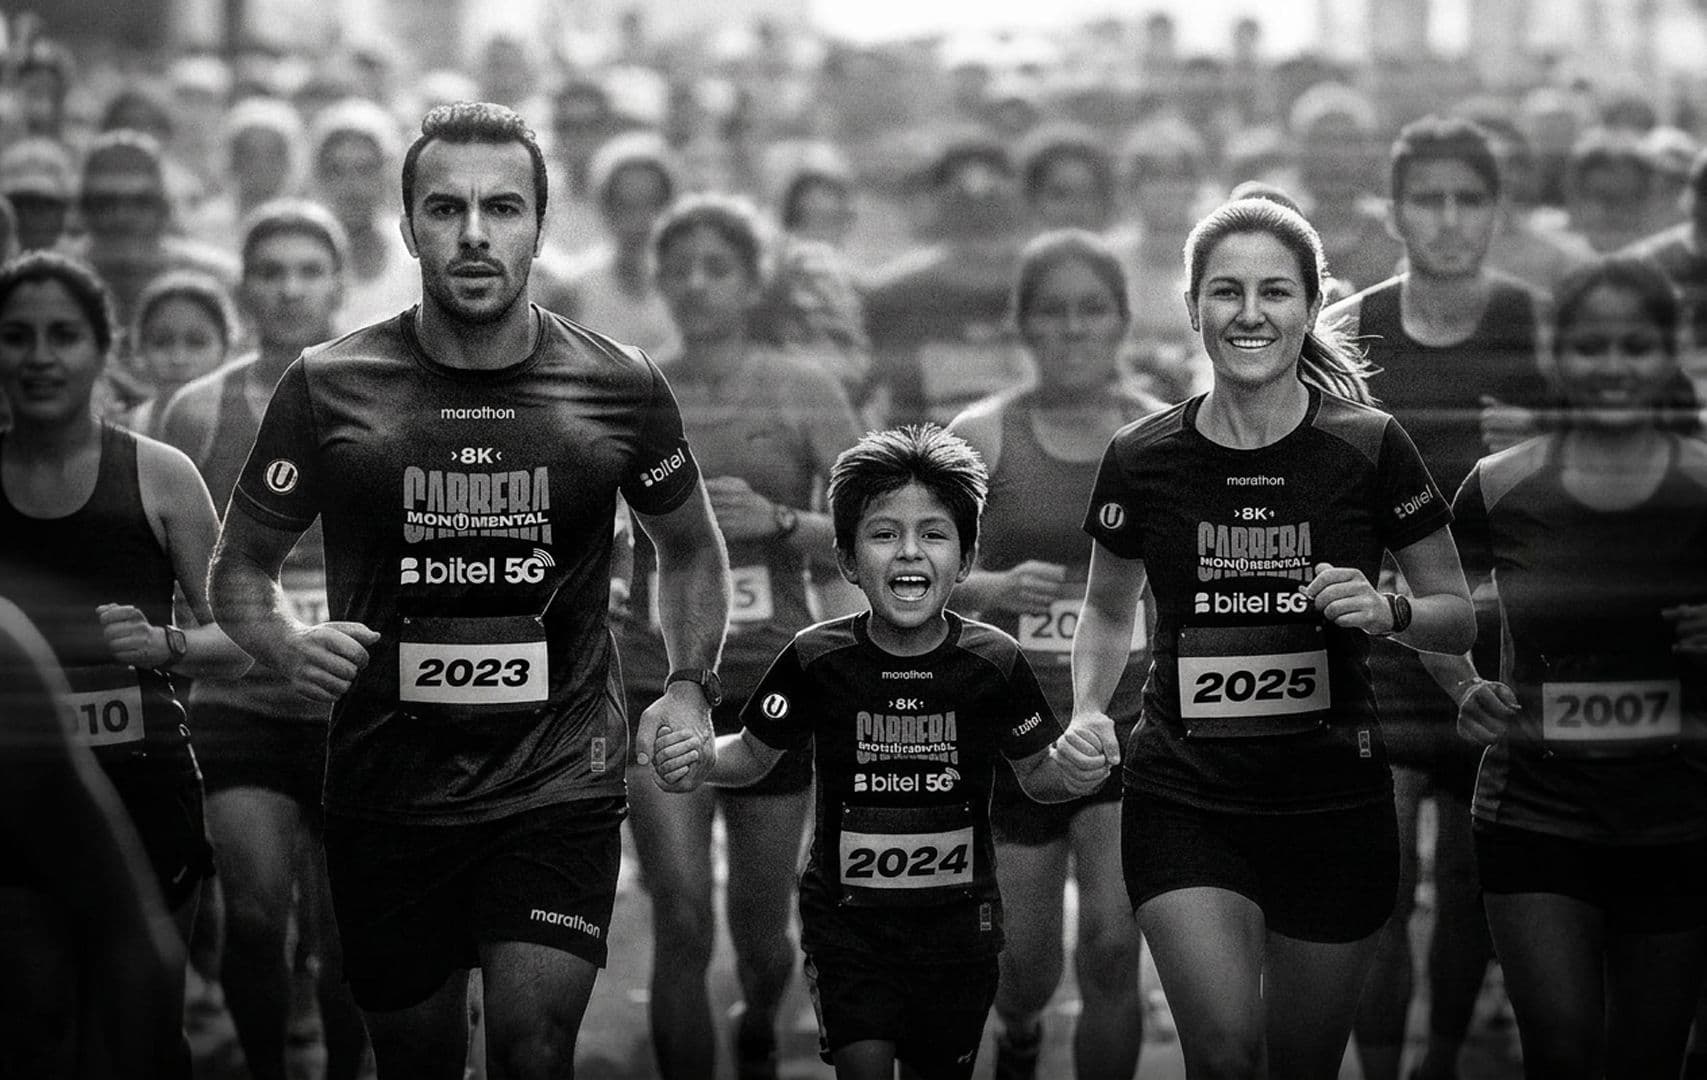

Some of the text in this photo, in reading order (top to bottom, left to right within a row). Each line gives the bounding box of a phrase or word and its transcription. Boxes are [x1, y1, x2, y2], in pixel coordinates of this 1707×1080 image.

[460, 447, 494, 464] 8K
[403, 466, 553, 545] CARRERA
[1242, 507, 1268, 520] 8K
[1197, 521, 1314, 582] CARRERA
[425, 556, 546, 585] bitel 5G
[1214, 592, 1308, 614] bitel 5G
[415, 658, 531, 688] 2023
[1193, 667, 1317, 703] 2025
[63, 700, 129, 735] 10
[895, 698, 918, 710] 8K
[1556, 691, 1670, 728] 2007
[871, 773, 954, 792] bitel 5G
[845, 844, 968, 878] 2024
